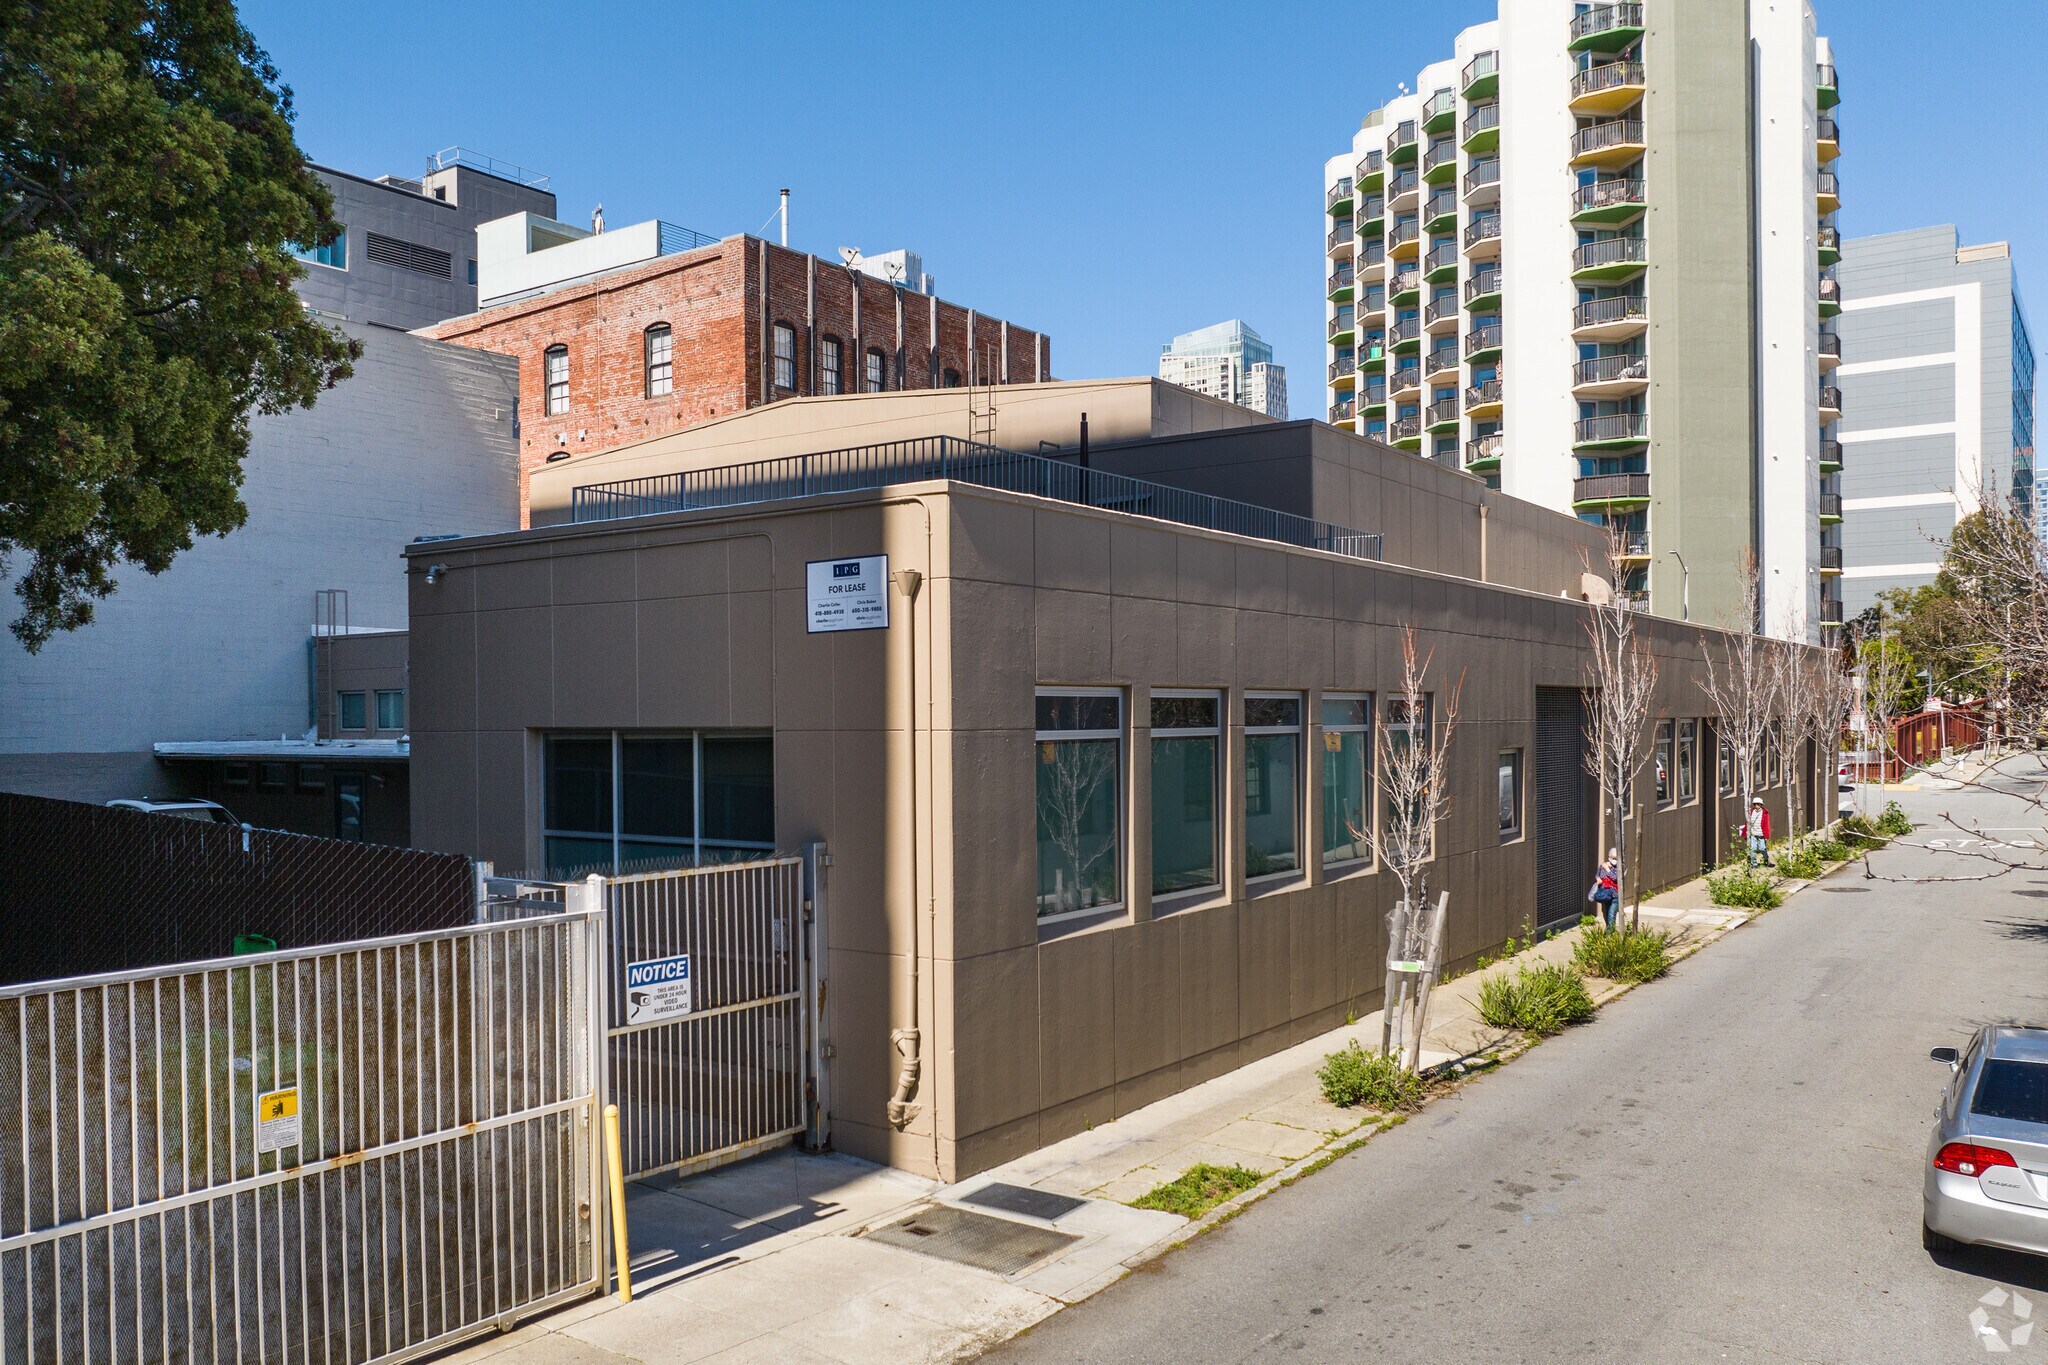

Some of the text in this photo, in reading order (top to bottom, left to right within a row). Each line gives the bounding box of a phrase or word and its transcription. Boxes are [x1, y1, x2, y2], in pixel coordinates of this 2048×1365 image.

[828, 583, 866, 594] FOR LEASE
[1925, 838, 2036, 849] STOP
[630, 960, 686, 985] NOTICE
[654, 1003, 688, 1014] SURVEILLANCE
[270, 1092, 297, 1101] WARNING
